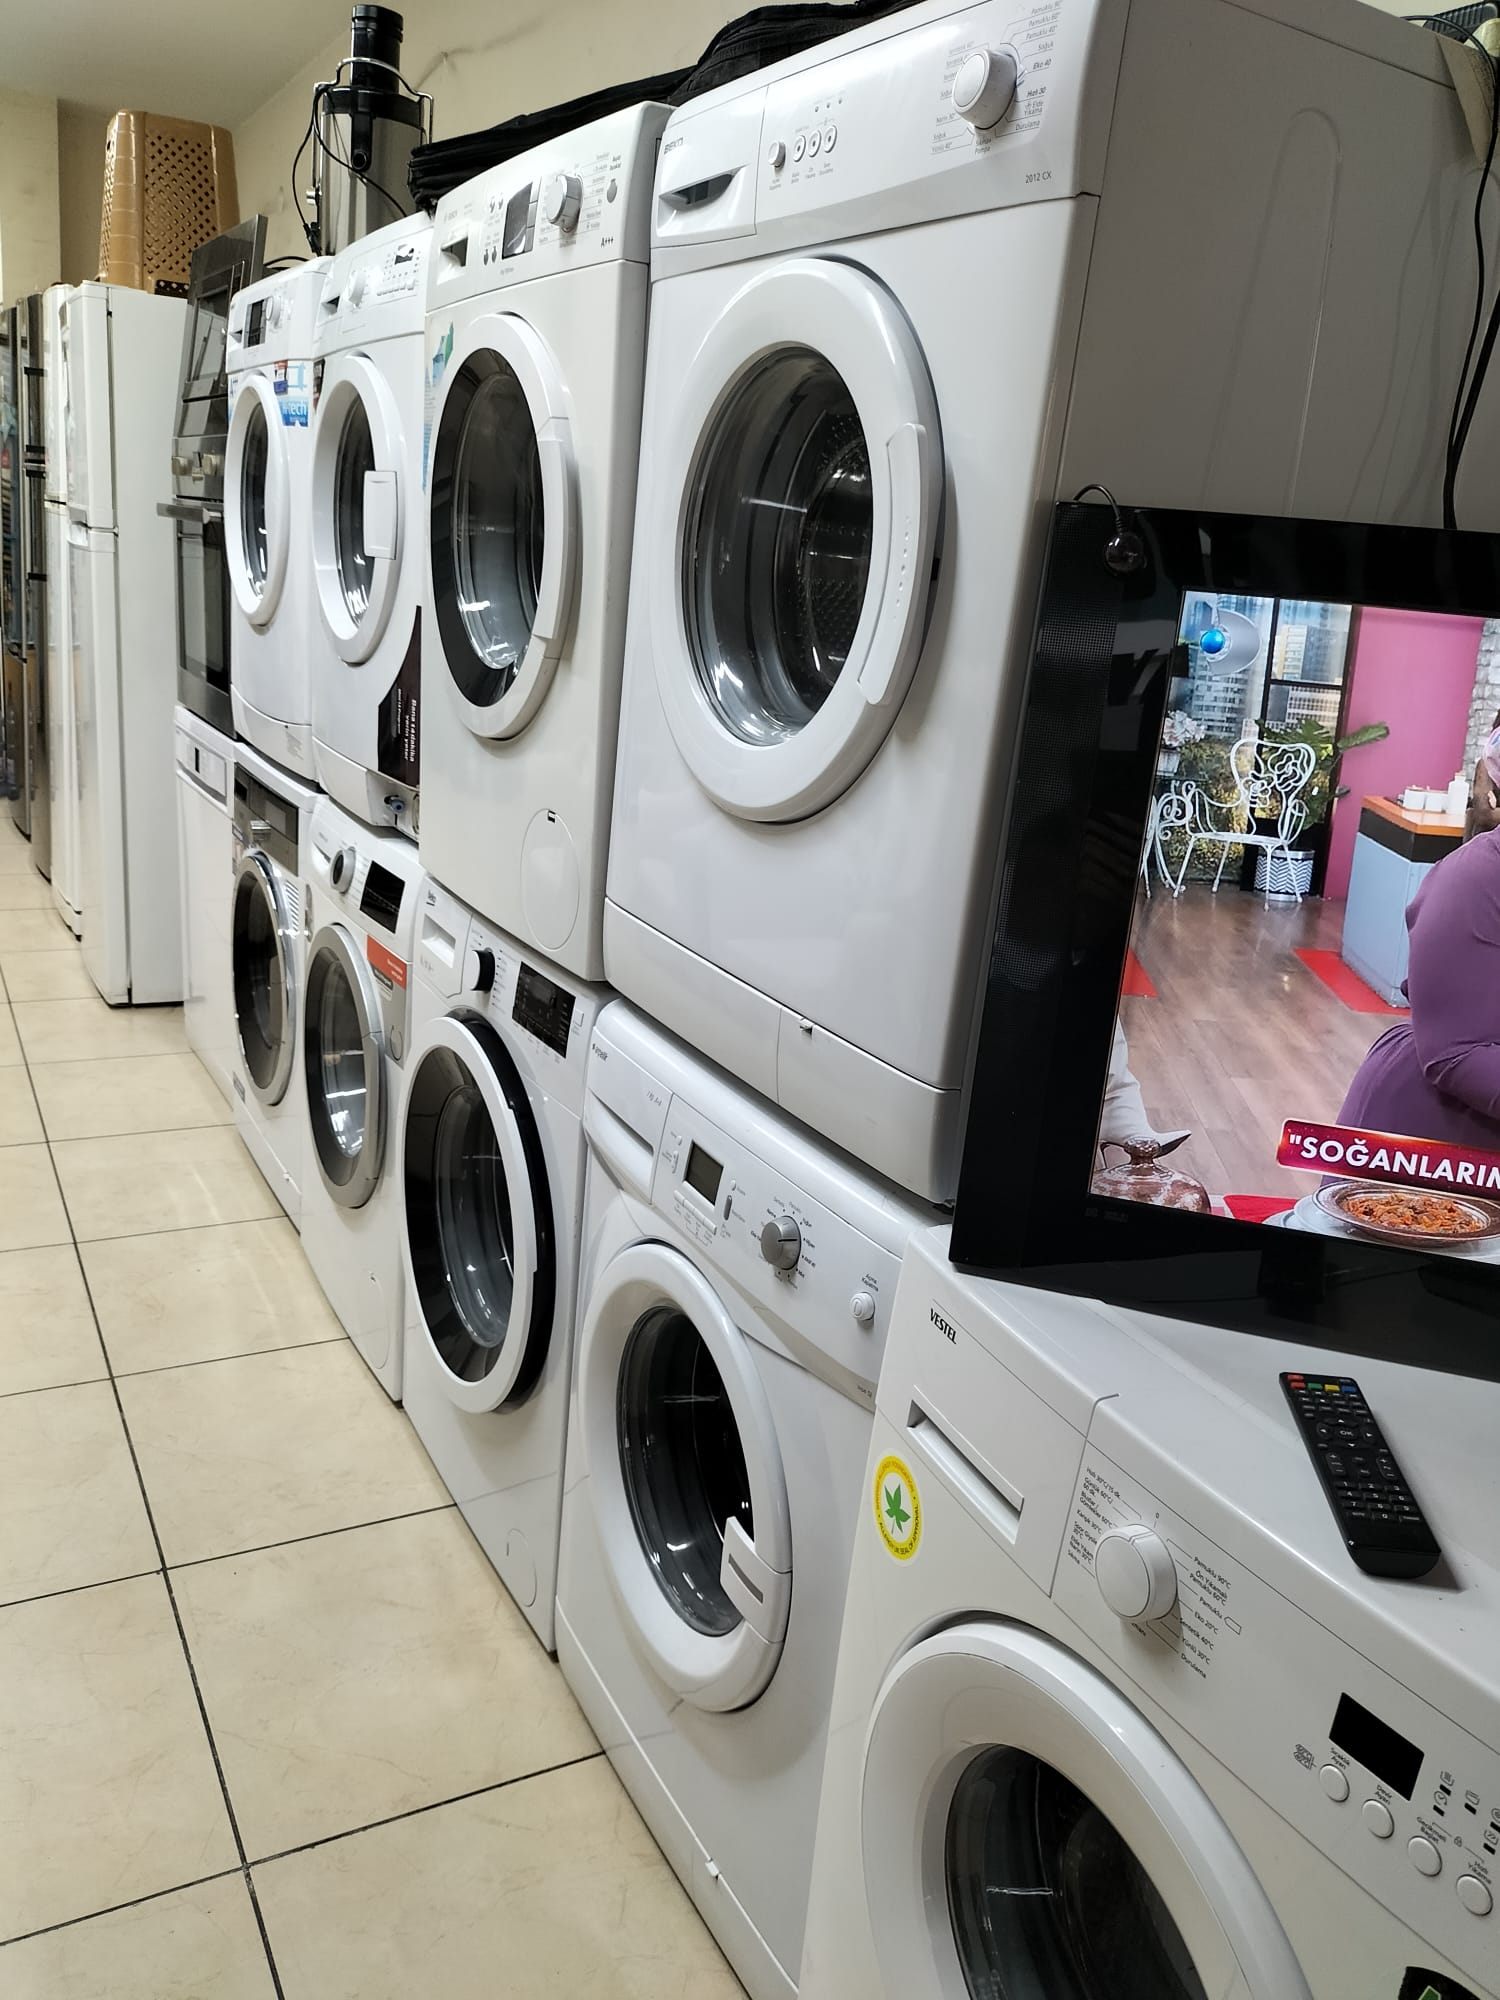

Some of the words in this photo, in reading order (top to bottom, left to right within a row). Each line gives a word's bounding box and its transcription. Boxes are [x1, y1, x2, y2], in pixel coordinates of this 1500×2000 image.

[1015, 120, 1040, 131] Durulama
[1025, 172, 1040, 184] 2012
[1041, 171, 1052, 181] CX
[930, 1308, 957, 1344] VESTEL
[1194, 1556, 1217, 1579] Pamuklu
[1189, 1573, 1213, 1595] Pamuklu
[1194, 1611, 1205, 1623] Eko
[1200, 1596, 1223, 1619] Pamuklu
[1182, 1638, 1197, 1653] Yünlü
[1181, 1653, 1207, 1679] Durulama
[1416, 1816, 1447, 1843] Gecikmeli
[1468, 1862, 1492, 1885] Yıkama
